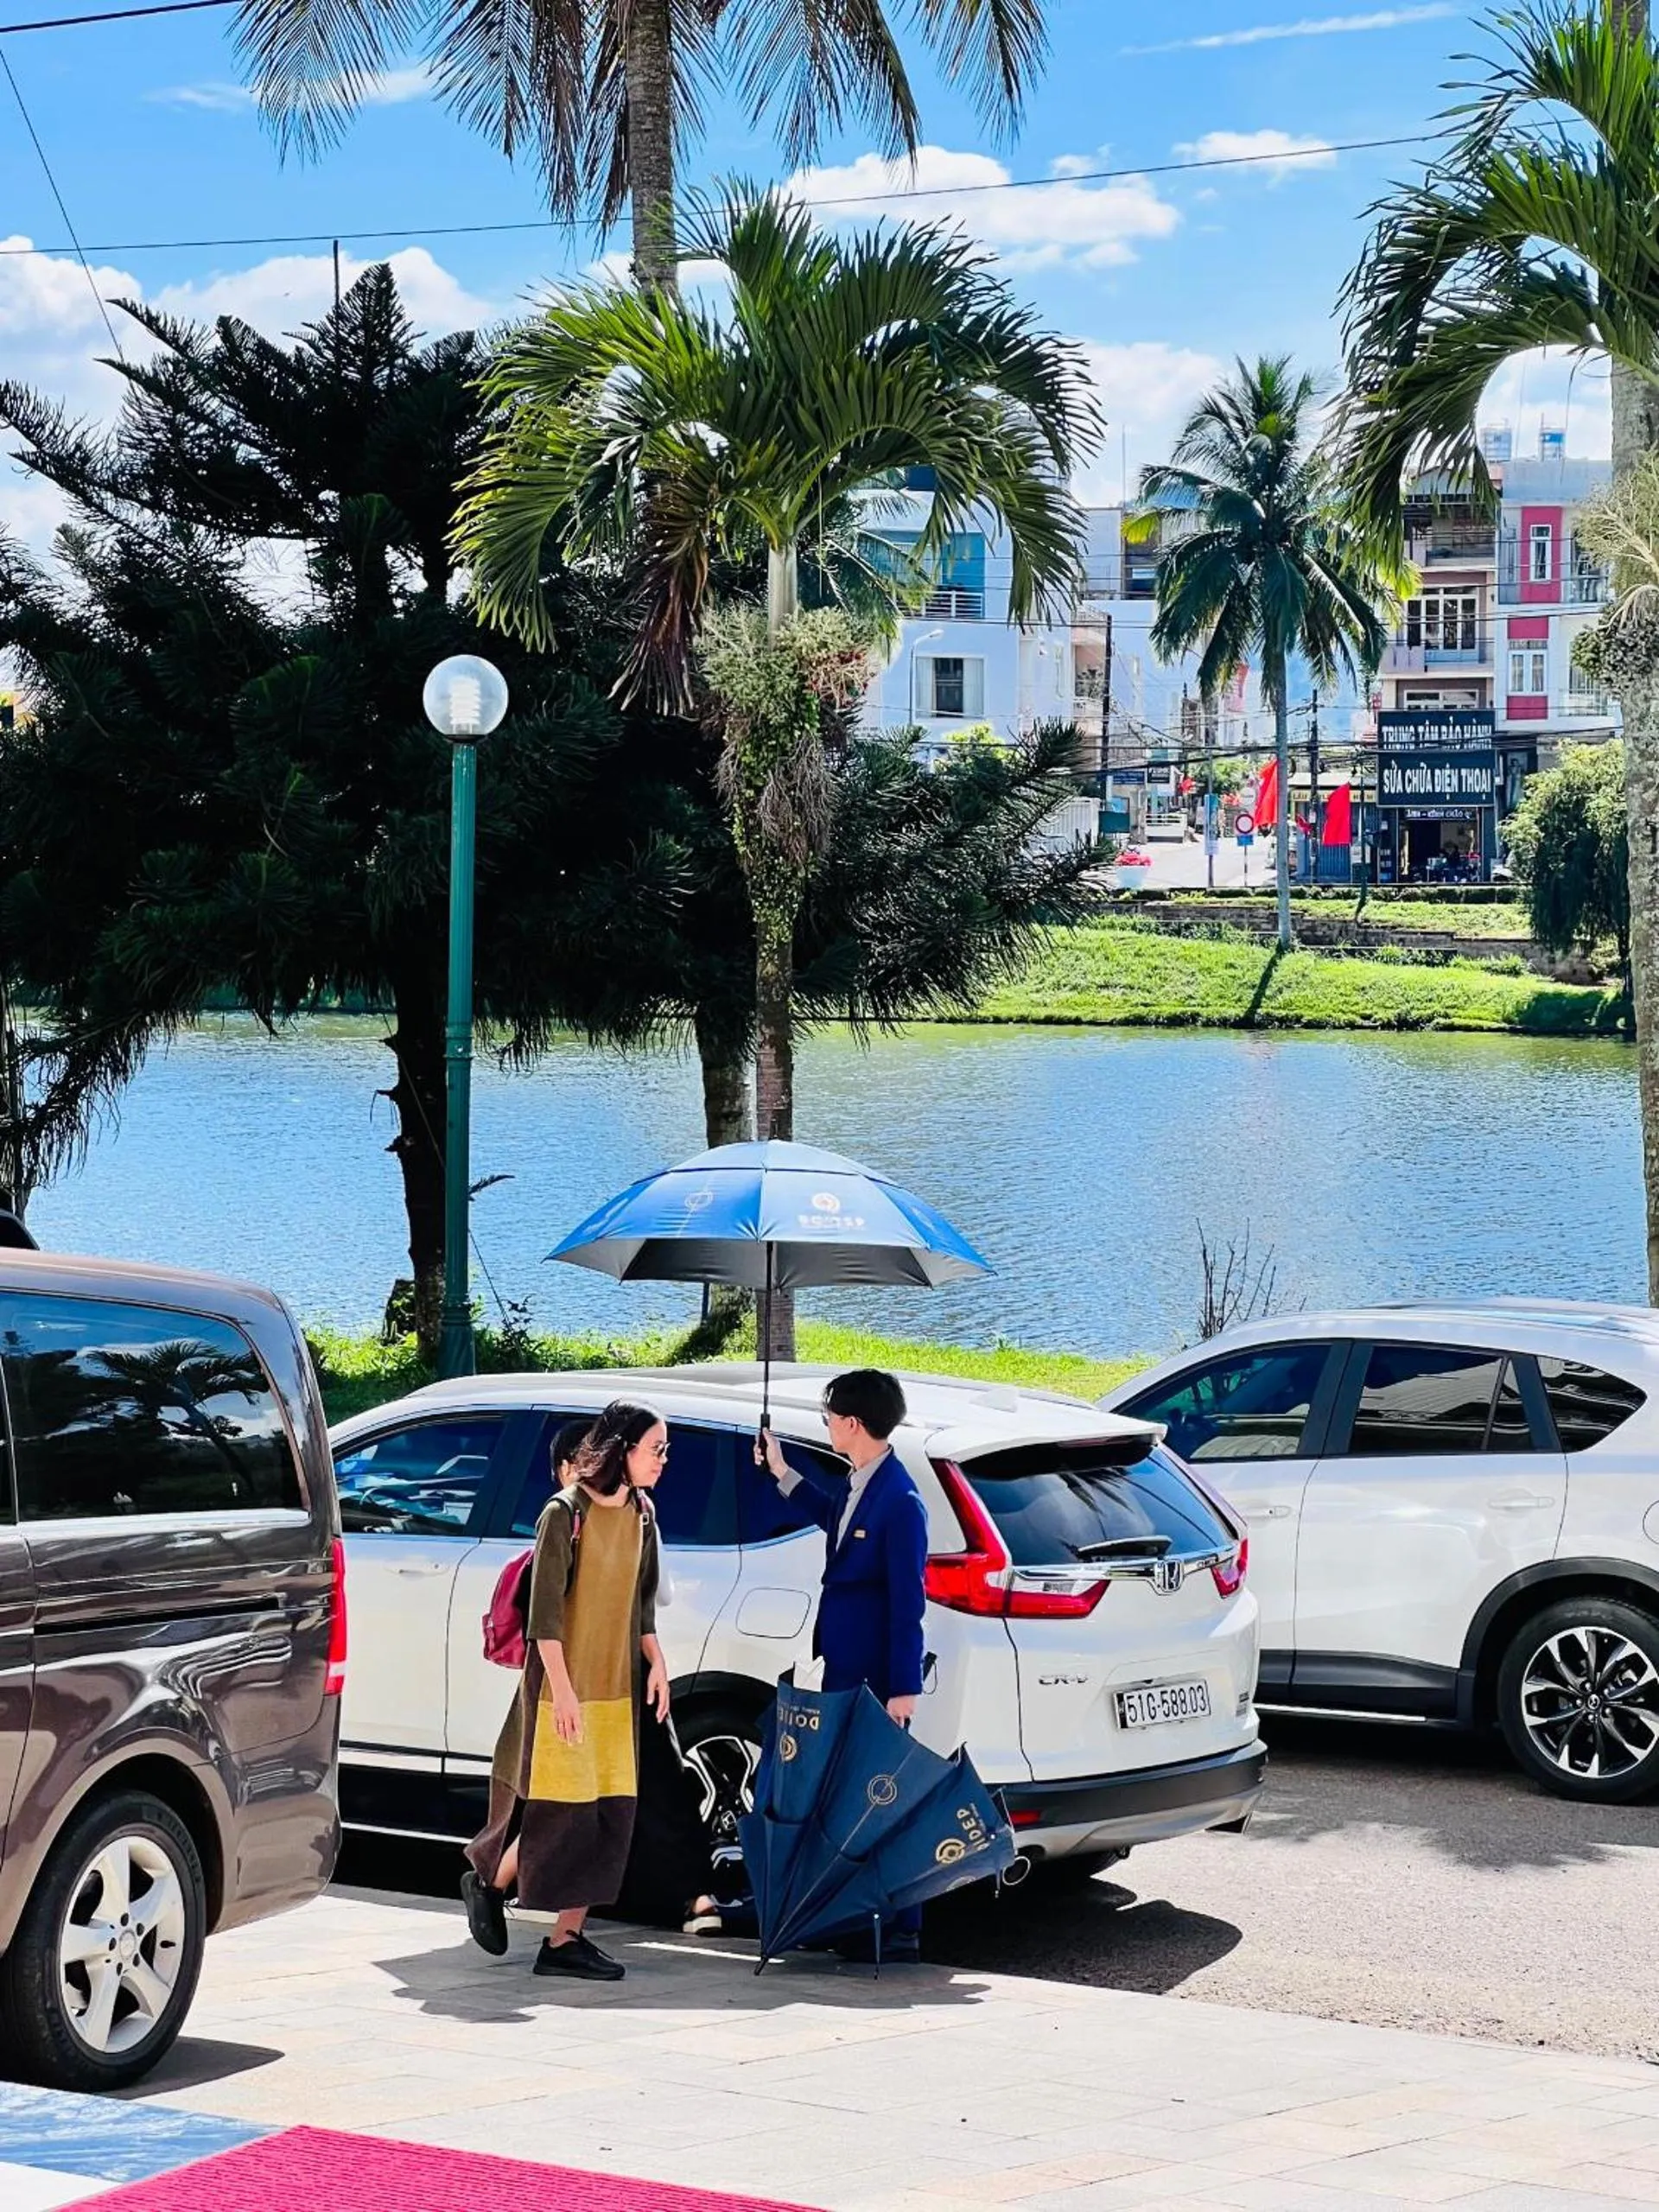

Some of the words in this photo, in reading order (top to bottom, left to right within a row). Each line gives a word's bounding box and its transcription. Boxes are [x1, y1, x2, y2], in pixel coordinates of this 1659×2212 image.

[1418, 719, 1439, 749] TÂM
[1464, 718, 1492, 750] HÀNH
[1382, 760, 1403, 794] SỬA
[1405, 761, 1433, 794] CHỮA
[1460, 767, 1491, 800] THOẠI
[1126, 1684, 1207, 1723] 51G-588.03
